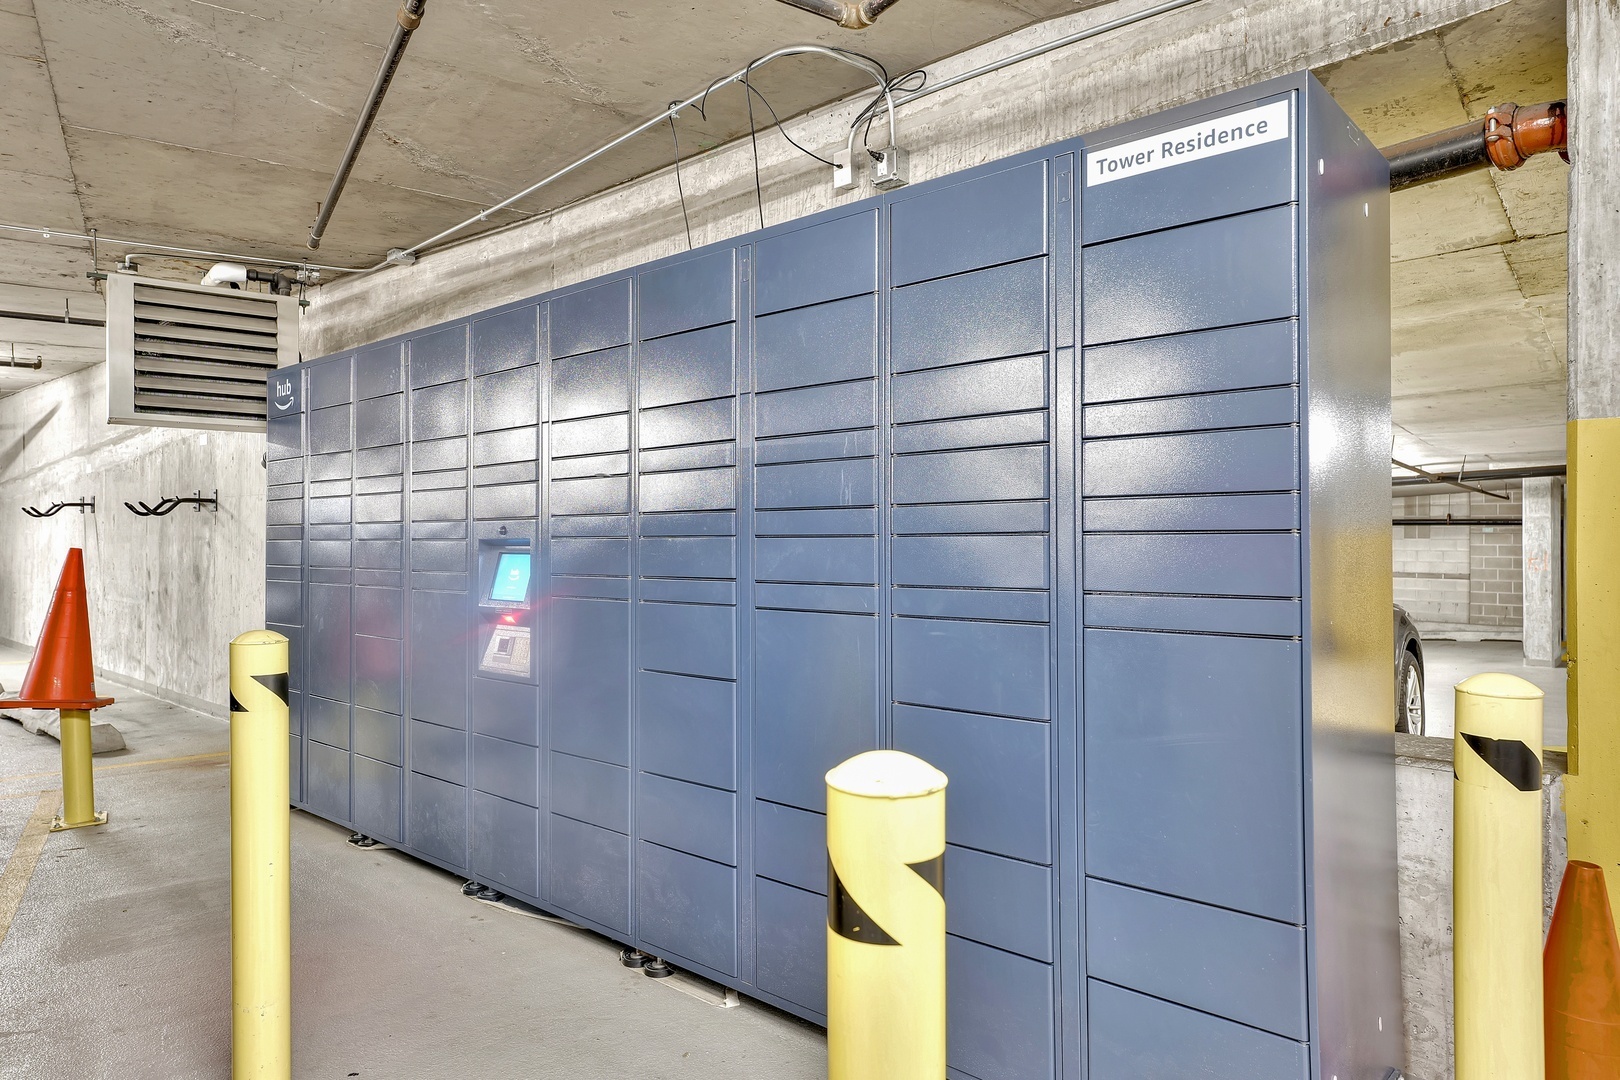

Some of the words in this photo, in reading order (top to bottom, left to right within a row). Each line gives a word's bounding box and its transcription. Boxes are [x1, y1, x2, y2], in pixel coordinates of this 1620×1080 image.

[1096, 148, 1155, 175] Tower
[1161, 120, 1268, 159] Residence
[276, 378, 292, 397] hub
